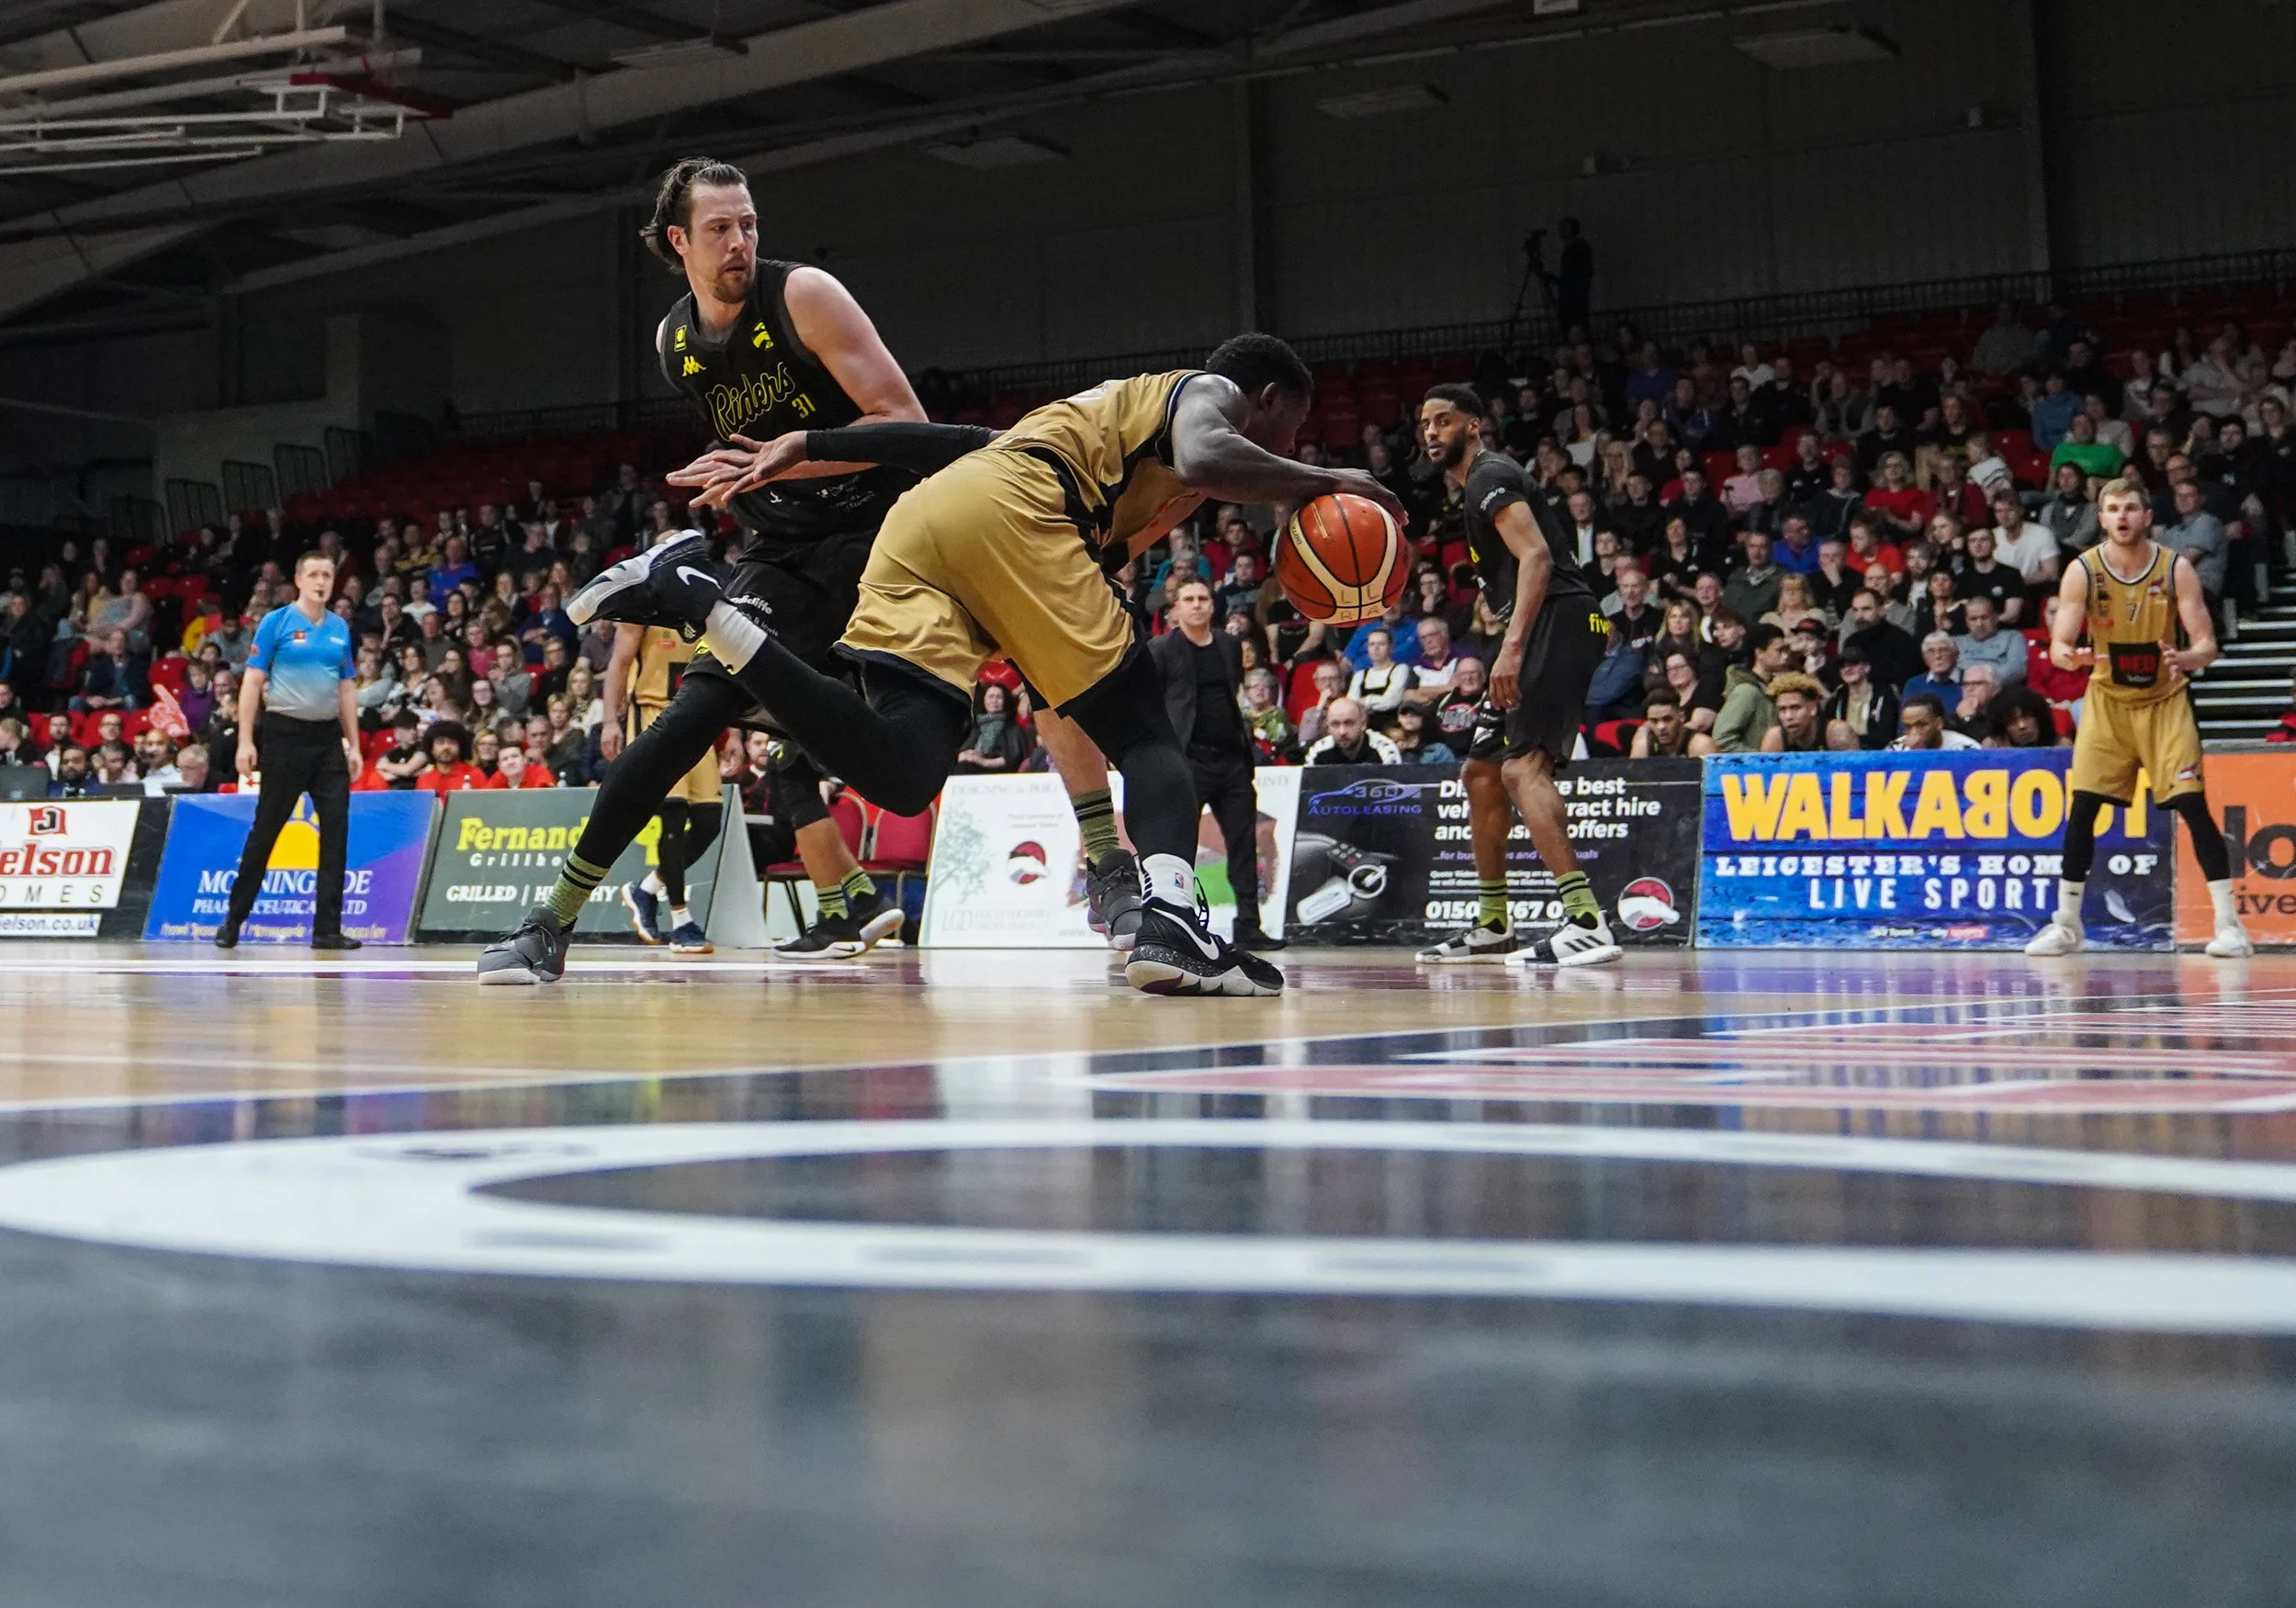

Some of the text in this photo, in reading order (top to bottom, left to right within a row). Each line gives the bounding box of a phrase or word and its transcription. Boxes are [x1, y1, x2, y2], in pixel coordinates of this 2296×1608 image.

[705, 361, 795, 443] Riders
[791, 393, 816, 419] 31
[2125, 602, 2142, 624] 7
[1577, 777, 1626, 795] best
[1308, 804, 1423, 815] AUTOLEASING
[1615, 797, 1661, 816] hire
[456, 816, 590, 851] Fernand
[1567, 820, 1629, 838] offers
[0, 842, 113, 876] elson
[469, 852, 562, 867] Grillho
[1716, 854, 2158, 876] LEICESTER'S HOM OF
[445, 884, 518, 902] GRILLED
[1809, 878, 2051, 910] LIVE SPORT
[1425, 901, 1480, 919] 0150
[0, 913, 96, 930] elson.co.uk
